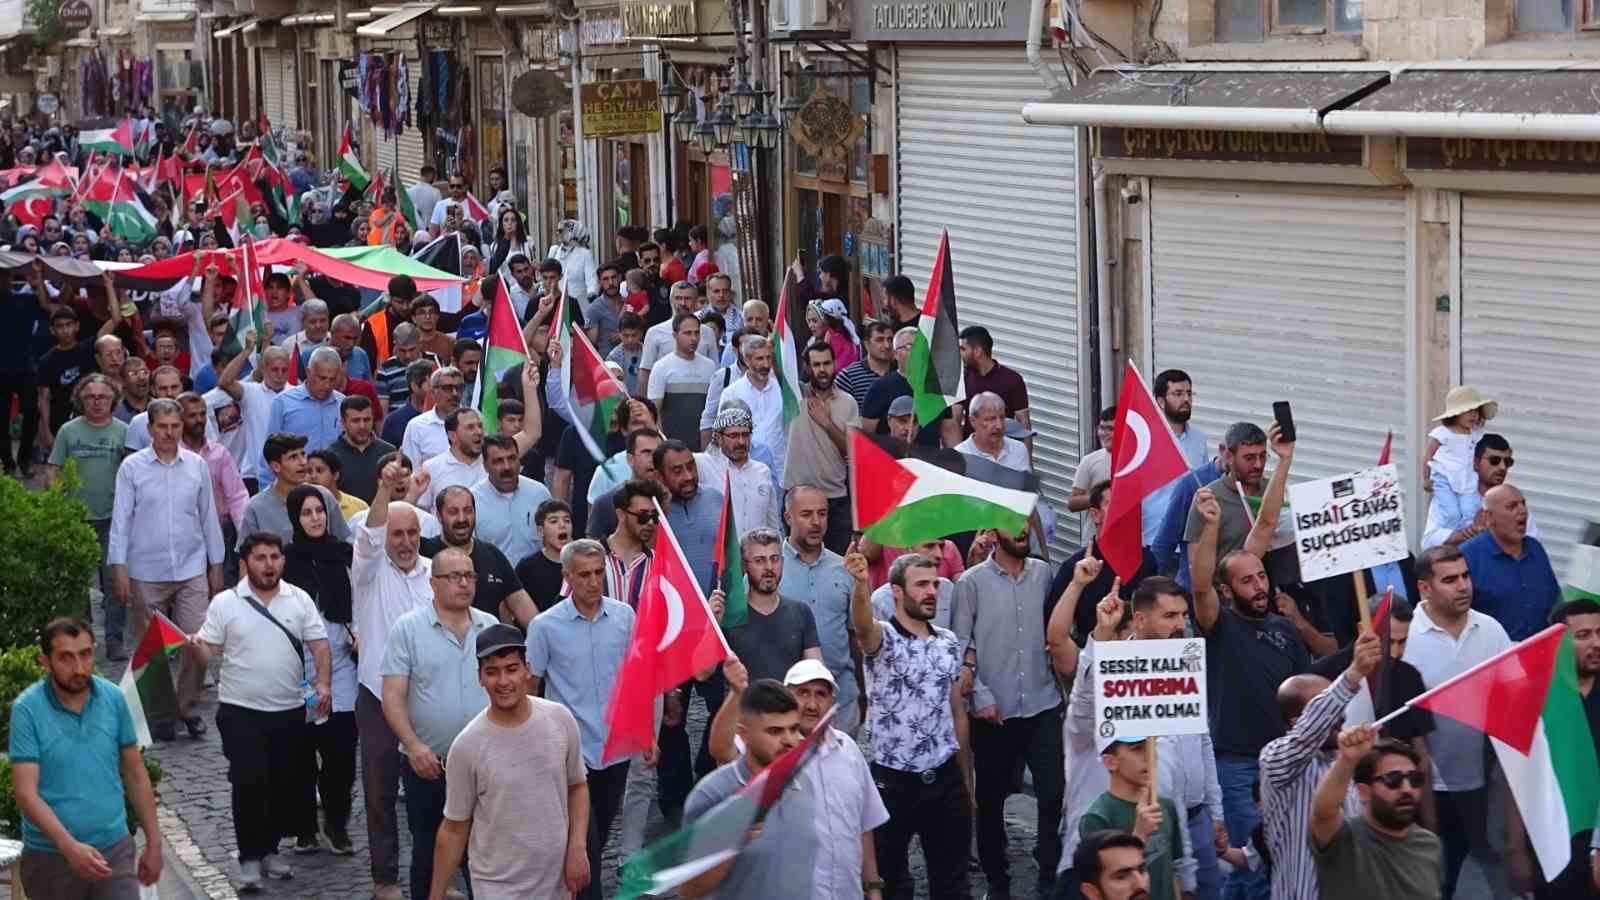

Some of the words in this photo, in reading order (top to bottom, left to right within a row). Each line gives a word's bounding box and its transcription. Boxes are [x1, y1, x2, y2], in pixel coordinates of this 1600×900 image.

[928, 1, 1006, 28] KUYUMCULUK
[1352, 494, 1398, 519] SAVAŞ
[1100, 656, 1148, 675] SESSİZ
[1104, 677, 1198, 698] SOYKIRIMA
[1104, 705, 1152, 720] ORTAK
[1155, 702, 1200, 719] OLMA!
